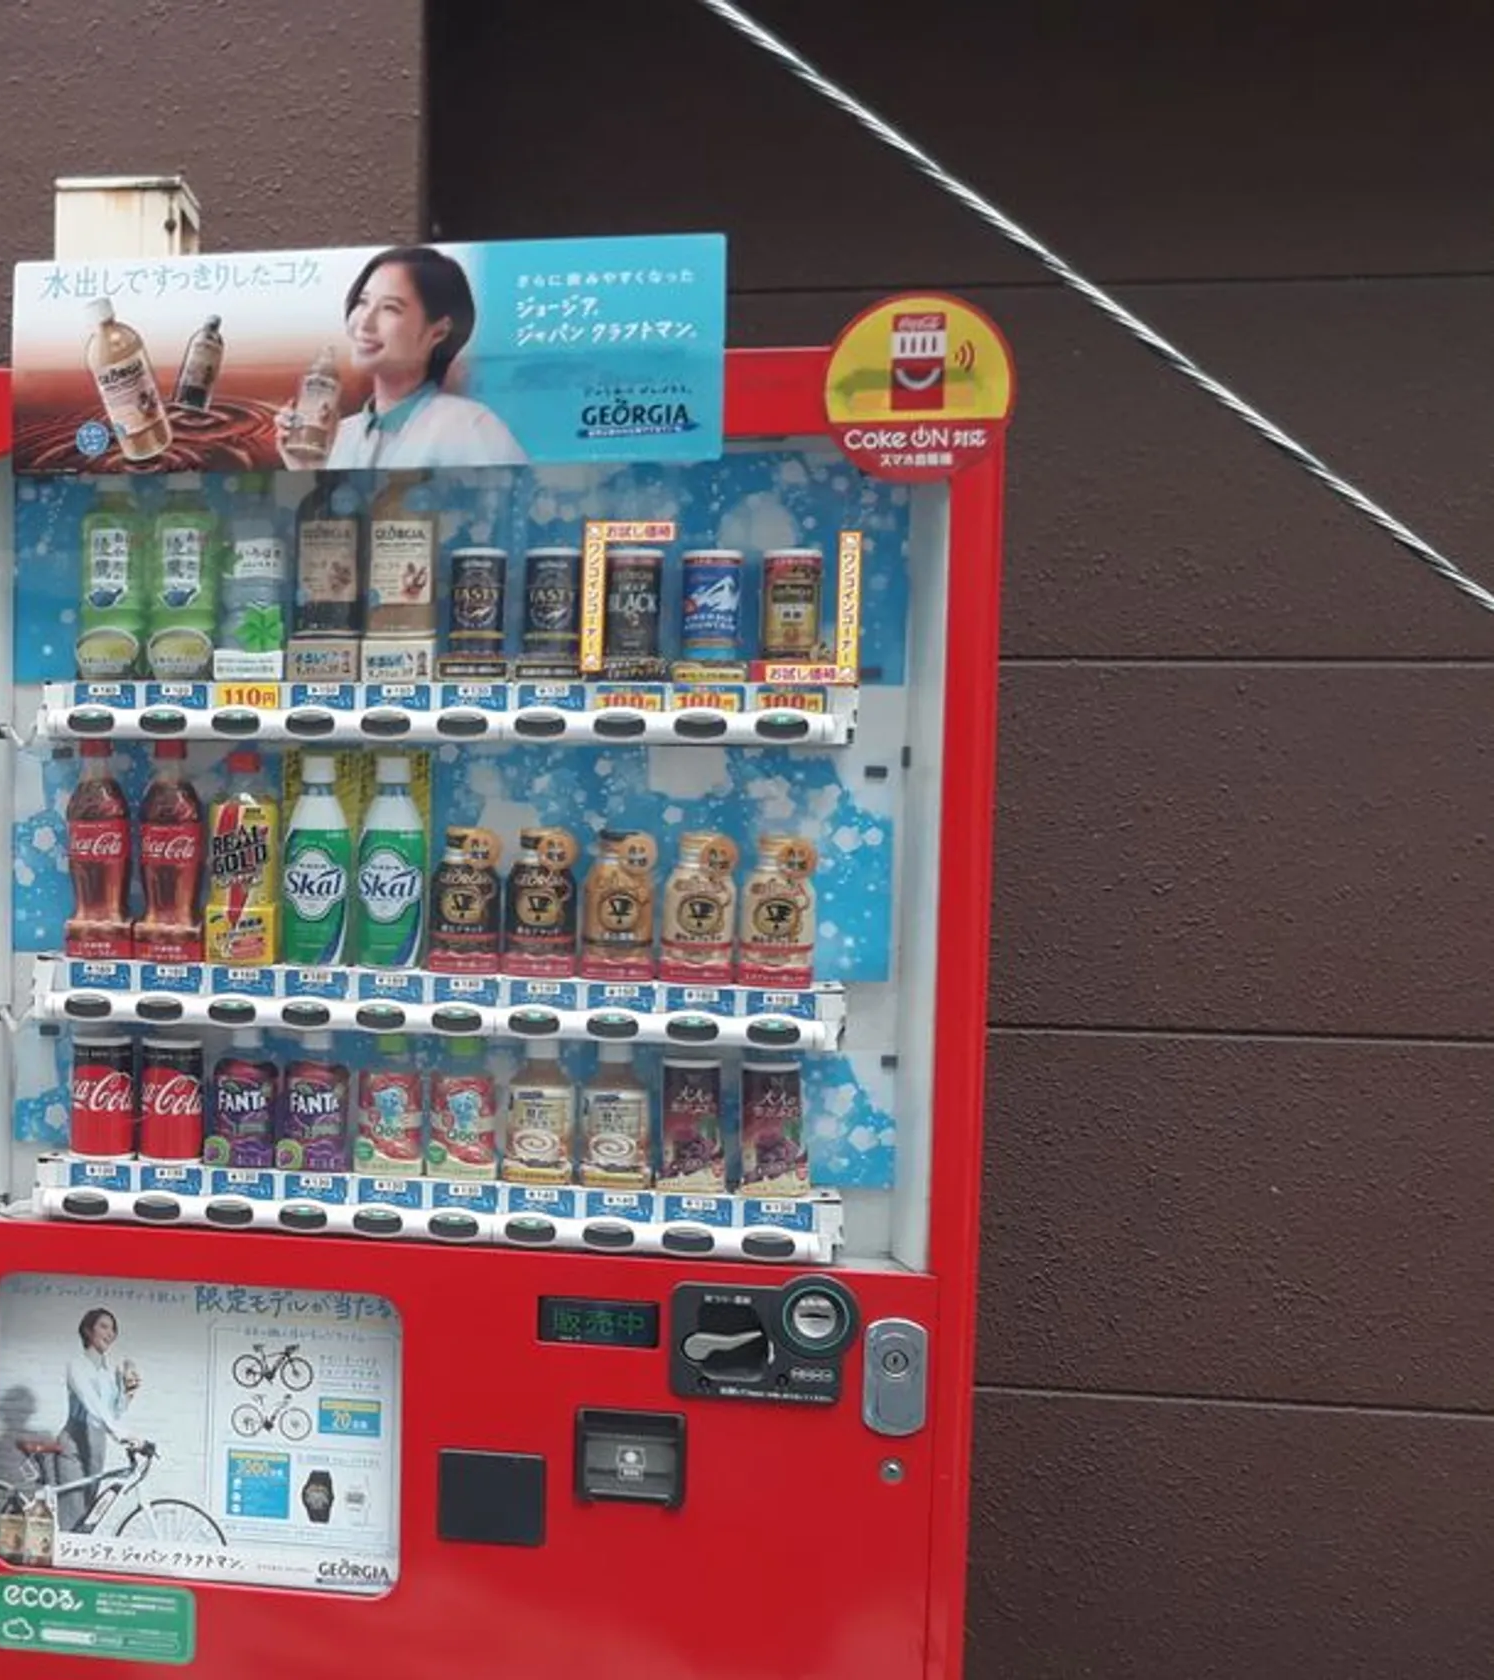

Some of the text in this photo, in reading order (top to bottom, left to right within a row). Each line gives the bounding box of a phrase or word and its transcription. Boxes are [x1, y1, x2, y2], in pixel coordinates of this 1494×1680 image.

[517, 268, 696, 289] さらに飲みやすくなった
[581, 400, 689, 427] GEORGIA
[843, 425, 987, 450] Coke ON 対応
[222, 688, 277, 707] 110円
[213, 824, 263, 856] REAL
[212, 844, 267, 875] GOLD
[217, 1089, 267, 1112] FANTA
[289, 1091, 340, 1114] FANTA
[372, 1123, 404, 1136] Qoo
[446, 1128, 477, 1143] Qoo
[552, 1307, 646, 1337] 販売中
[318, 1558, 390, 1580] GEORGIA
